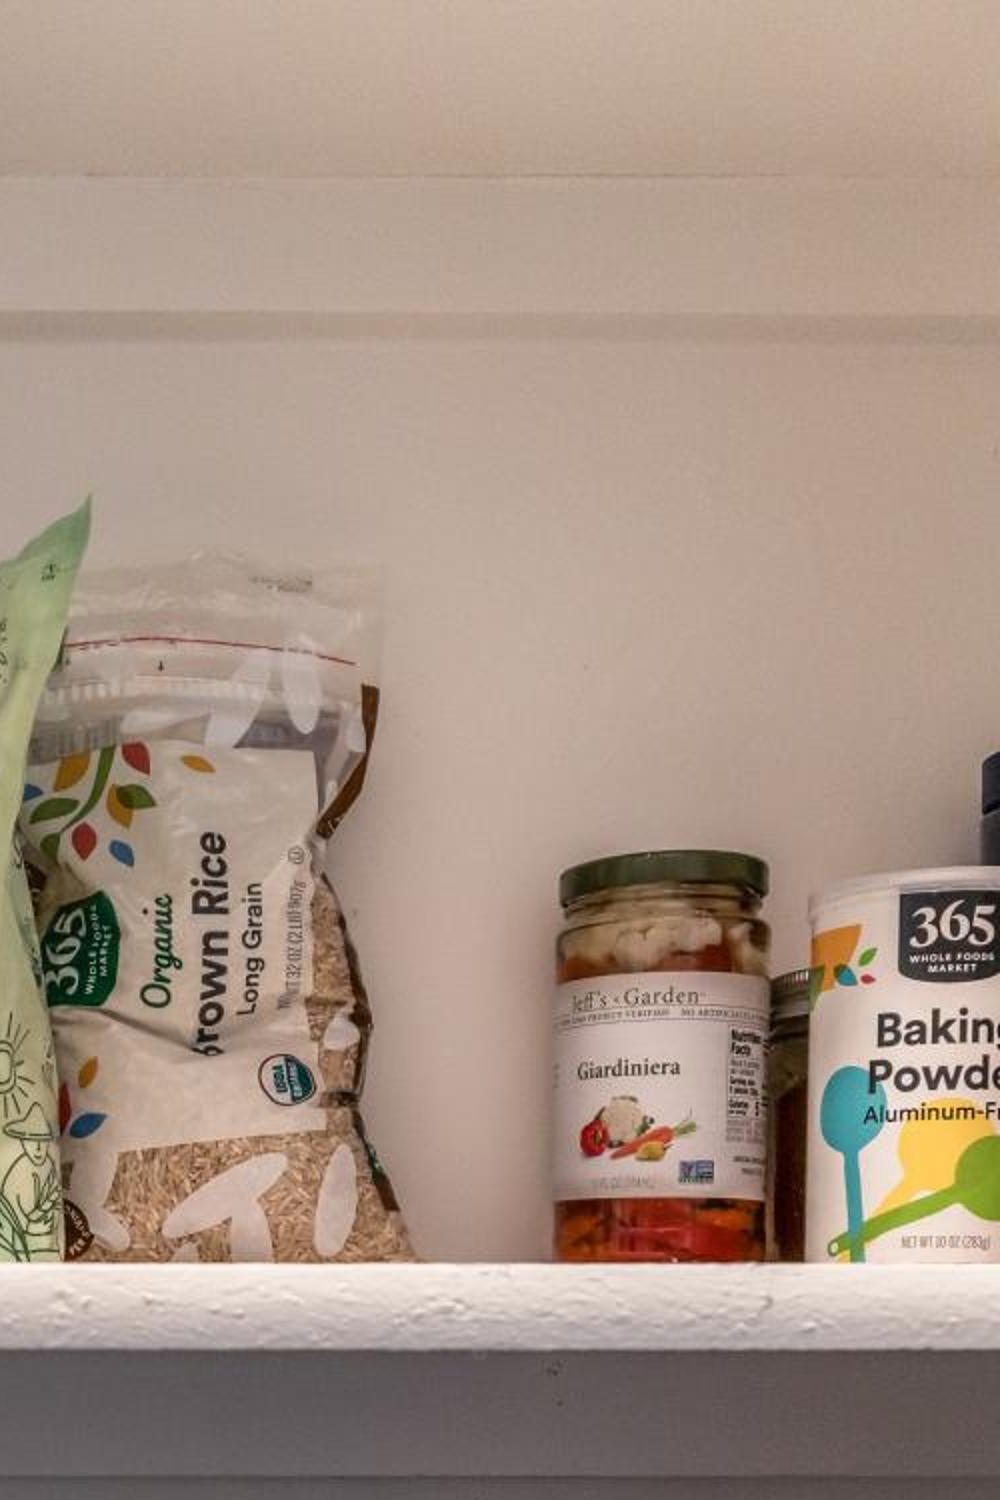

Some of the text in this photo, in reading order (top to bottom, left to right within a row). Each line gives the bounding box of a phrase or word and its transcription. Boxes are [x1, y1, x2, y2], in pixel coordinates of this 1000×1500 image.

[190, 831, 230, 915] Rice
[909, 900, 996, 949] 365
[45, 907, 87, 995] 365
[99, 924, 113, 977] MARKET
[139, 893, 184, 1009] Organic
[236, 882, 265, 1016] Long Grain
[909, 951, 995, 964] WHOLE FOODS
[927, 963, 977, 974] MARKET
[83, 950, 98, 996] WHOLE
[622, 986, 699, 1006] Garden
[877, 1007, 1000, 1050] Bakin
[577, 1057, 681, 1081] Giardiniera
[901, 1235, 917, 1249] NET
